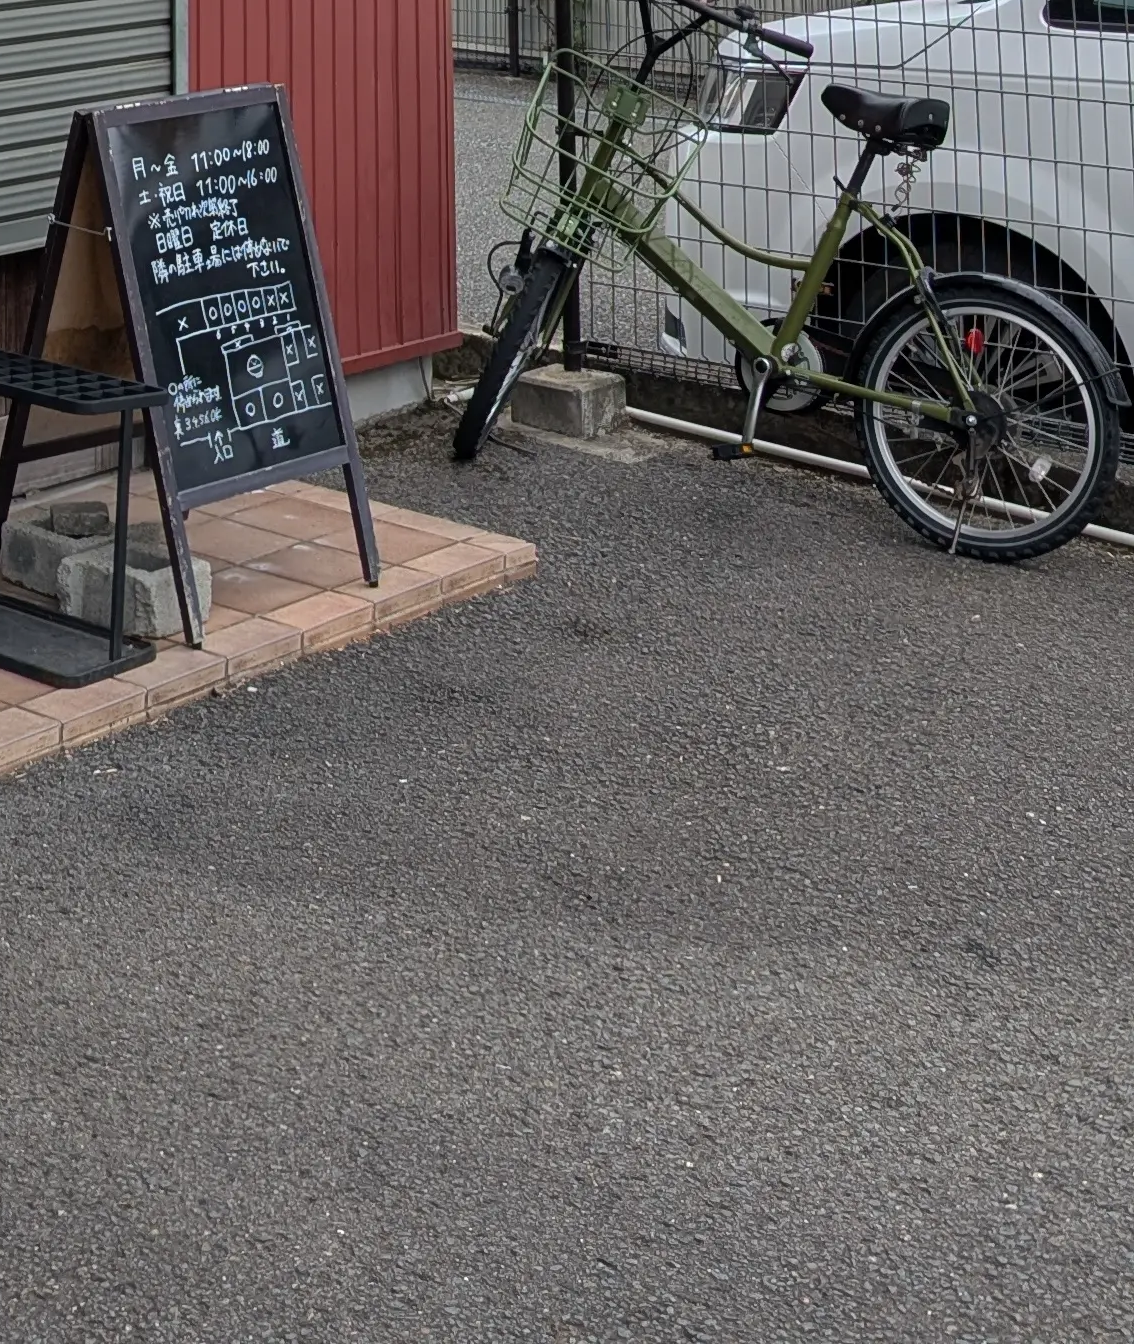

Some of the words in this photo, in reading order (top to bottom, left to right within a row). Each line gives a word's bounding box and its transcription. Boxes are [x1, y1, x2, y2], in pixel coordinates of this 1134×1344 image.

[156, 225, 193, 253] 日曜日
[209, 217, 248, 241] 定休日
[271, 427, 290, 449] 道
[213, 444, 234, 464] 入口
